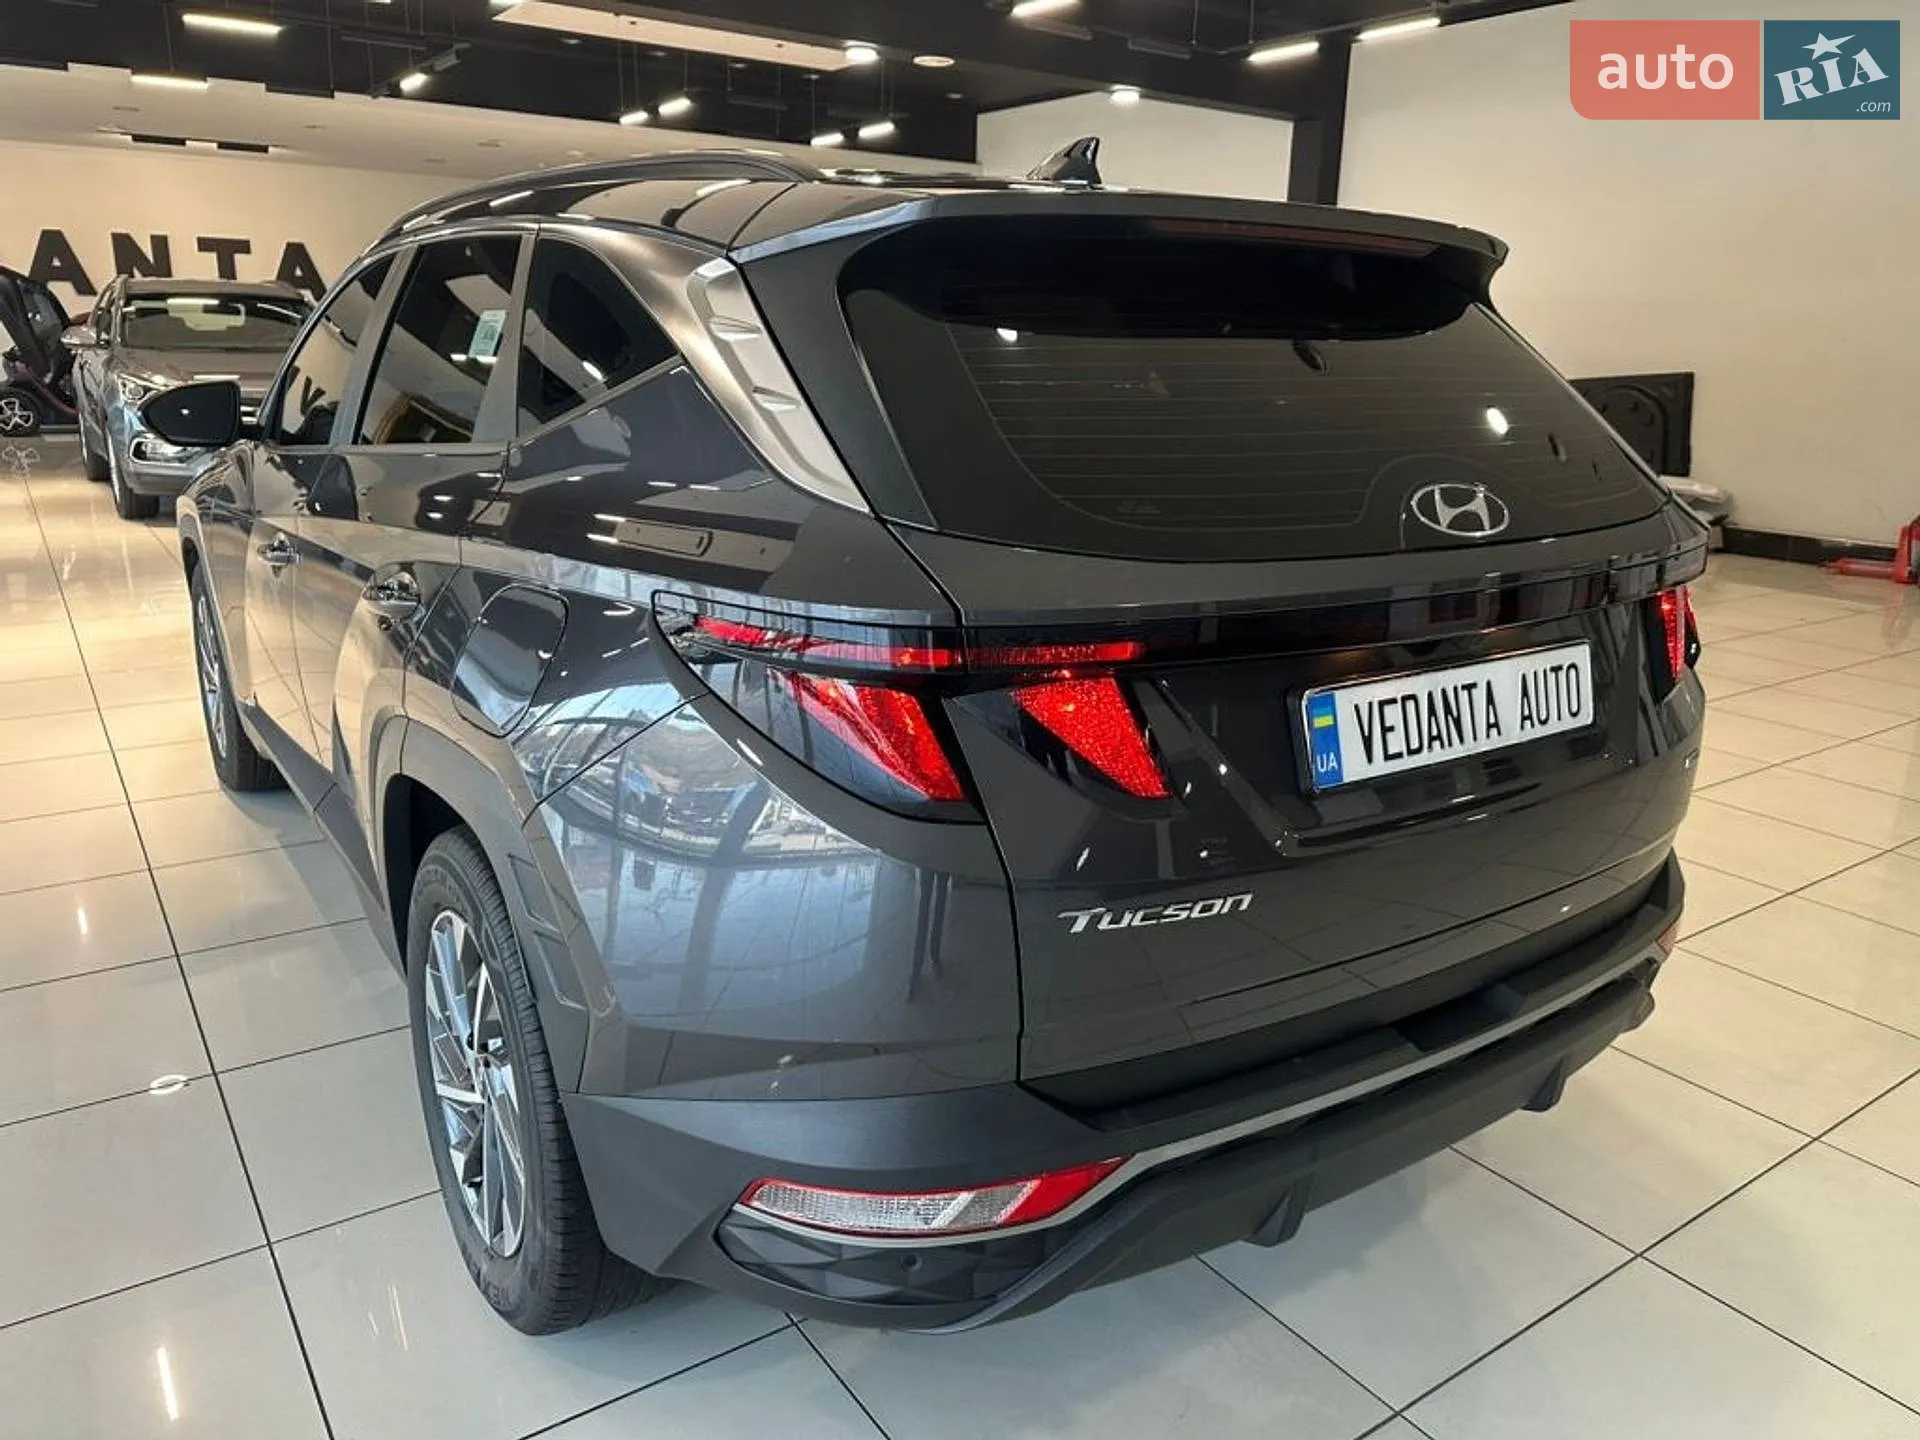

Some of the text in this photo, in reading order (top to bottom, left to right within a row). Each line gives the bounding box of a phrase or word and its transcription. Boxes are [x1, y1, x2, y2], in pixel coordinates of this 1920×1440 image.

[1353, 661, 1581, 765] VEDANTA AUTO
[1315, 754, 1339, 774] UA
